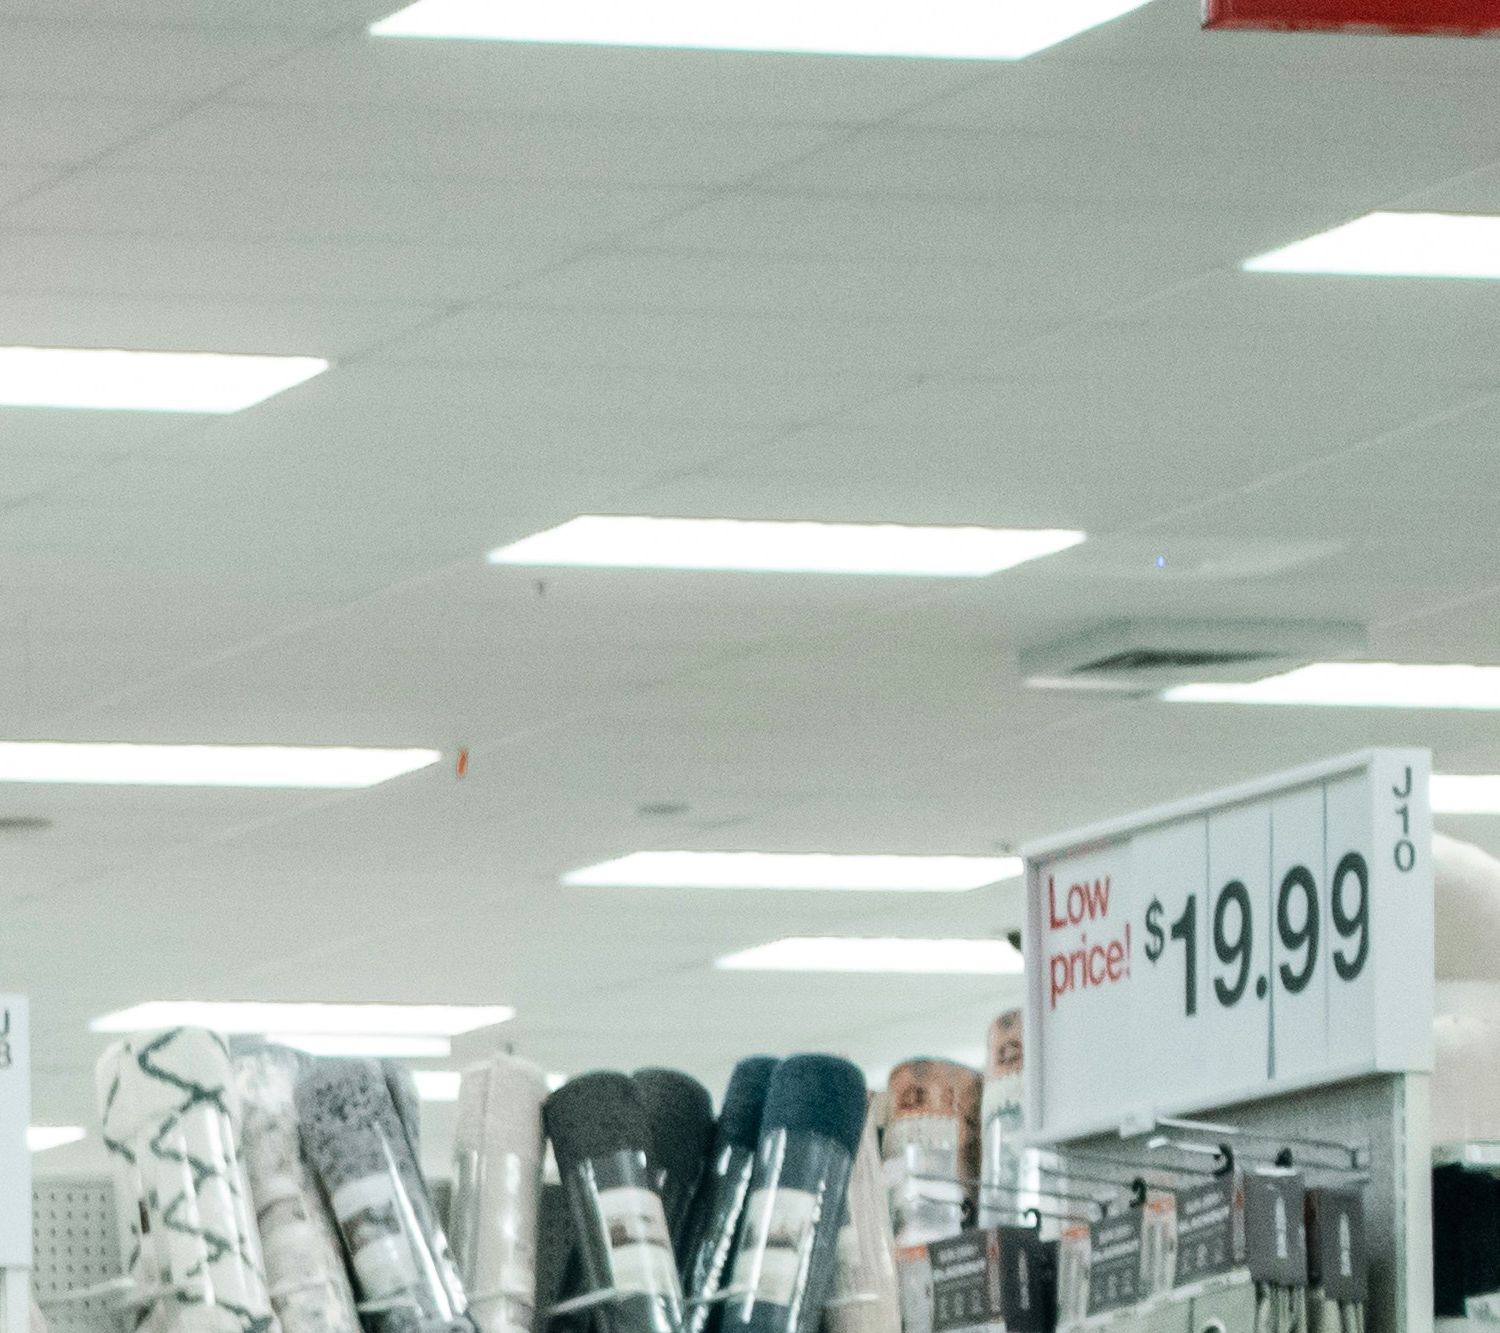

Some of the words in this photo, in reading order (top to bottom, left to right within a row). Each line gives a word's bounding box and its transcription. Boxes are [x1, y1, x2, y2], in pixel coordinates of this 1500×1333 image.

[1048, 874, 1112, 931] Low
[1144, 850, 1370, 1018] $19.99
[1049, 921, 1132, 1010] price!
